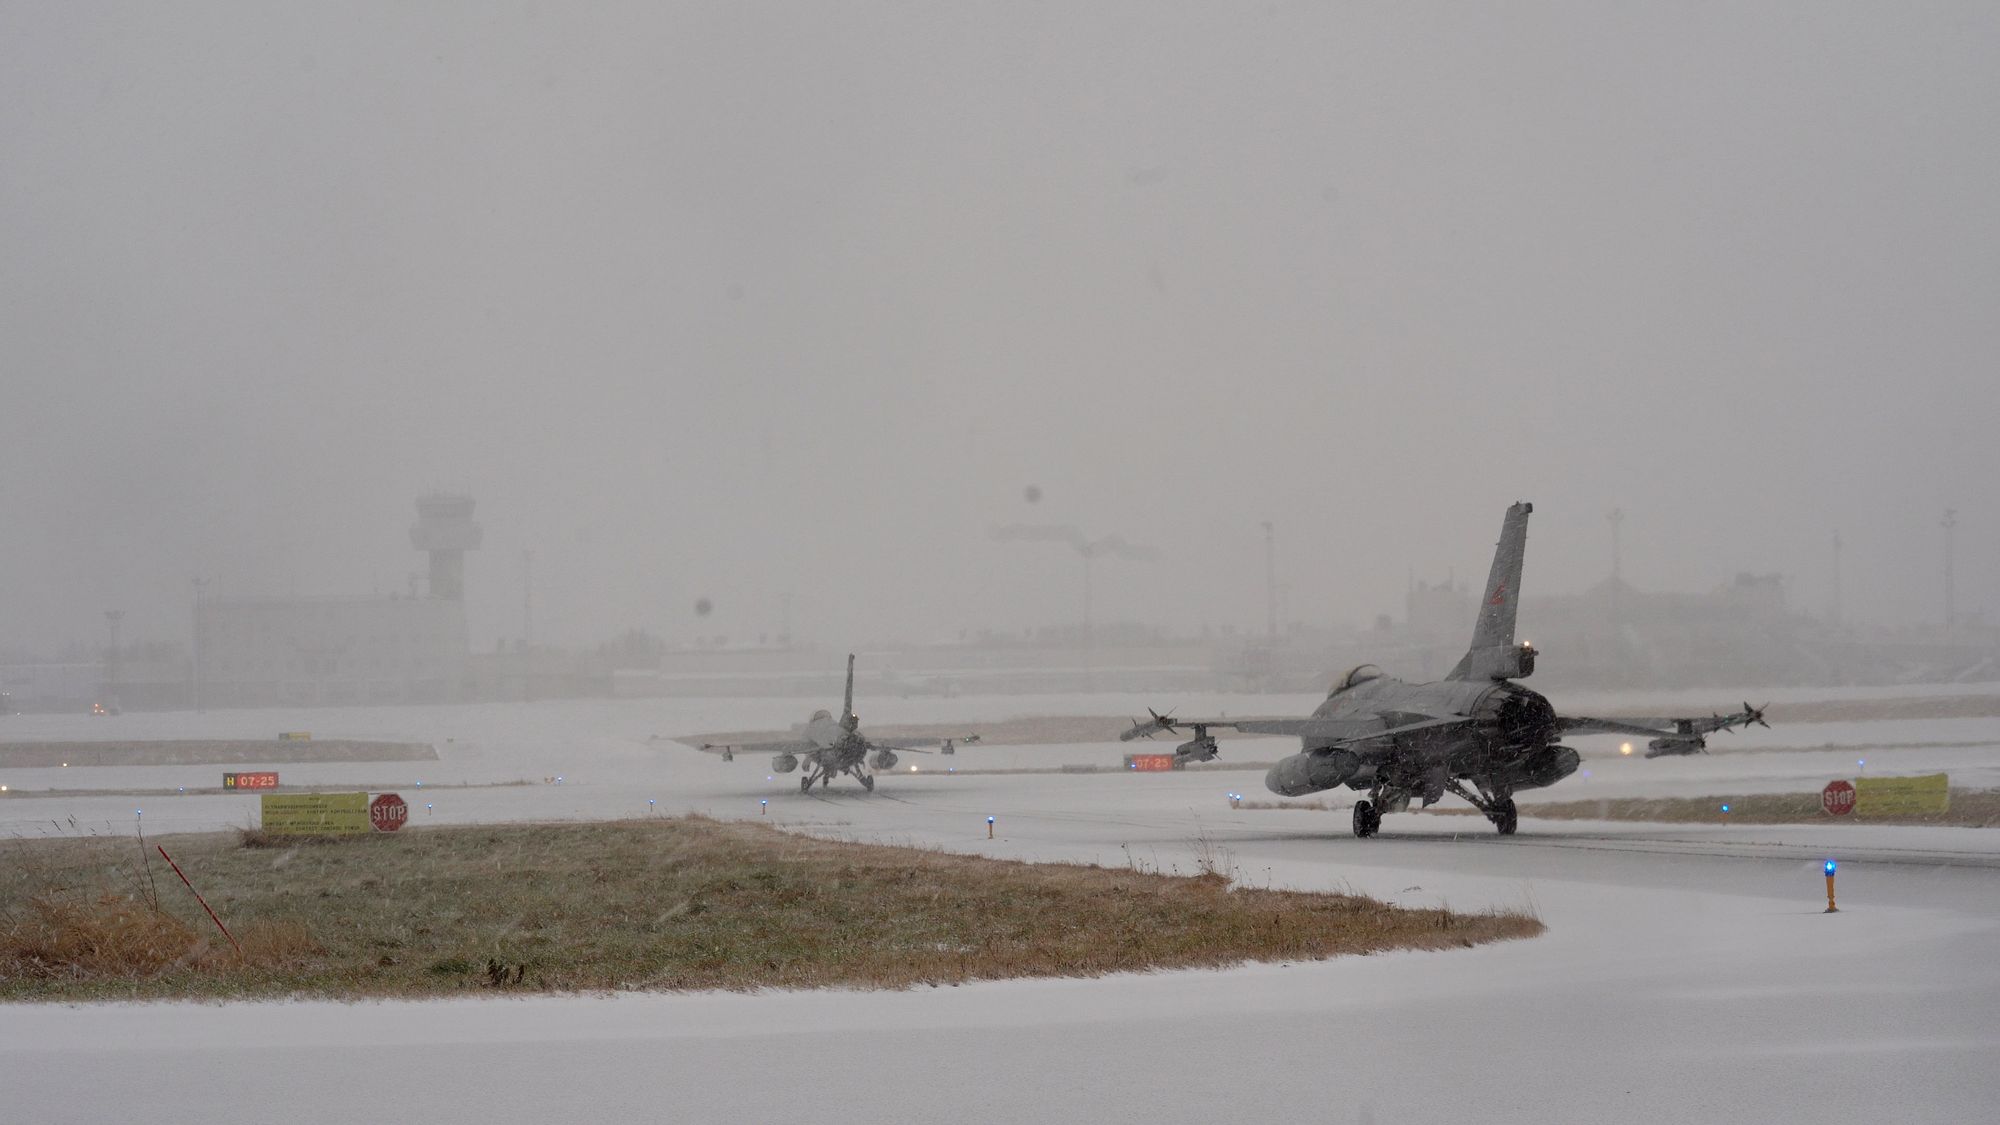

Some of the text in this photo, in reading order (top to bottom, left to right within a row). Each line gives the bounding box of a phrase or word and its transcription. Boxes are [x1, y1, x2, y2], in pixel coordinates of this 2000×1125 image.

[227, 776, 275, 786] H 07-25
[1824, 789, 1854, 806] STOP
[373, 804, 405, 821] STOP
